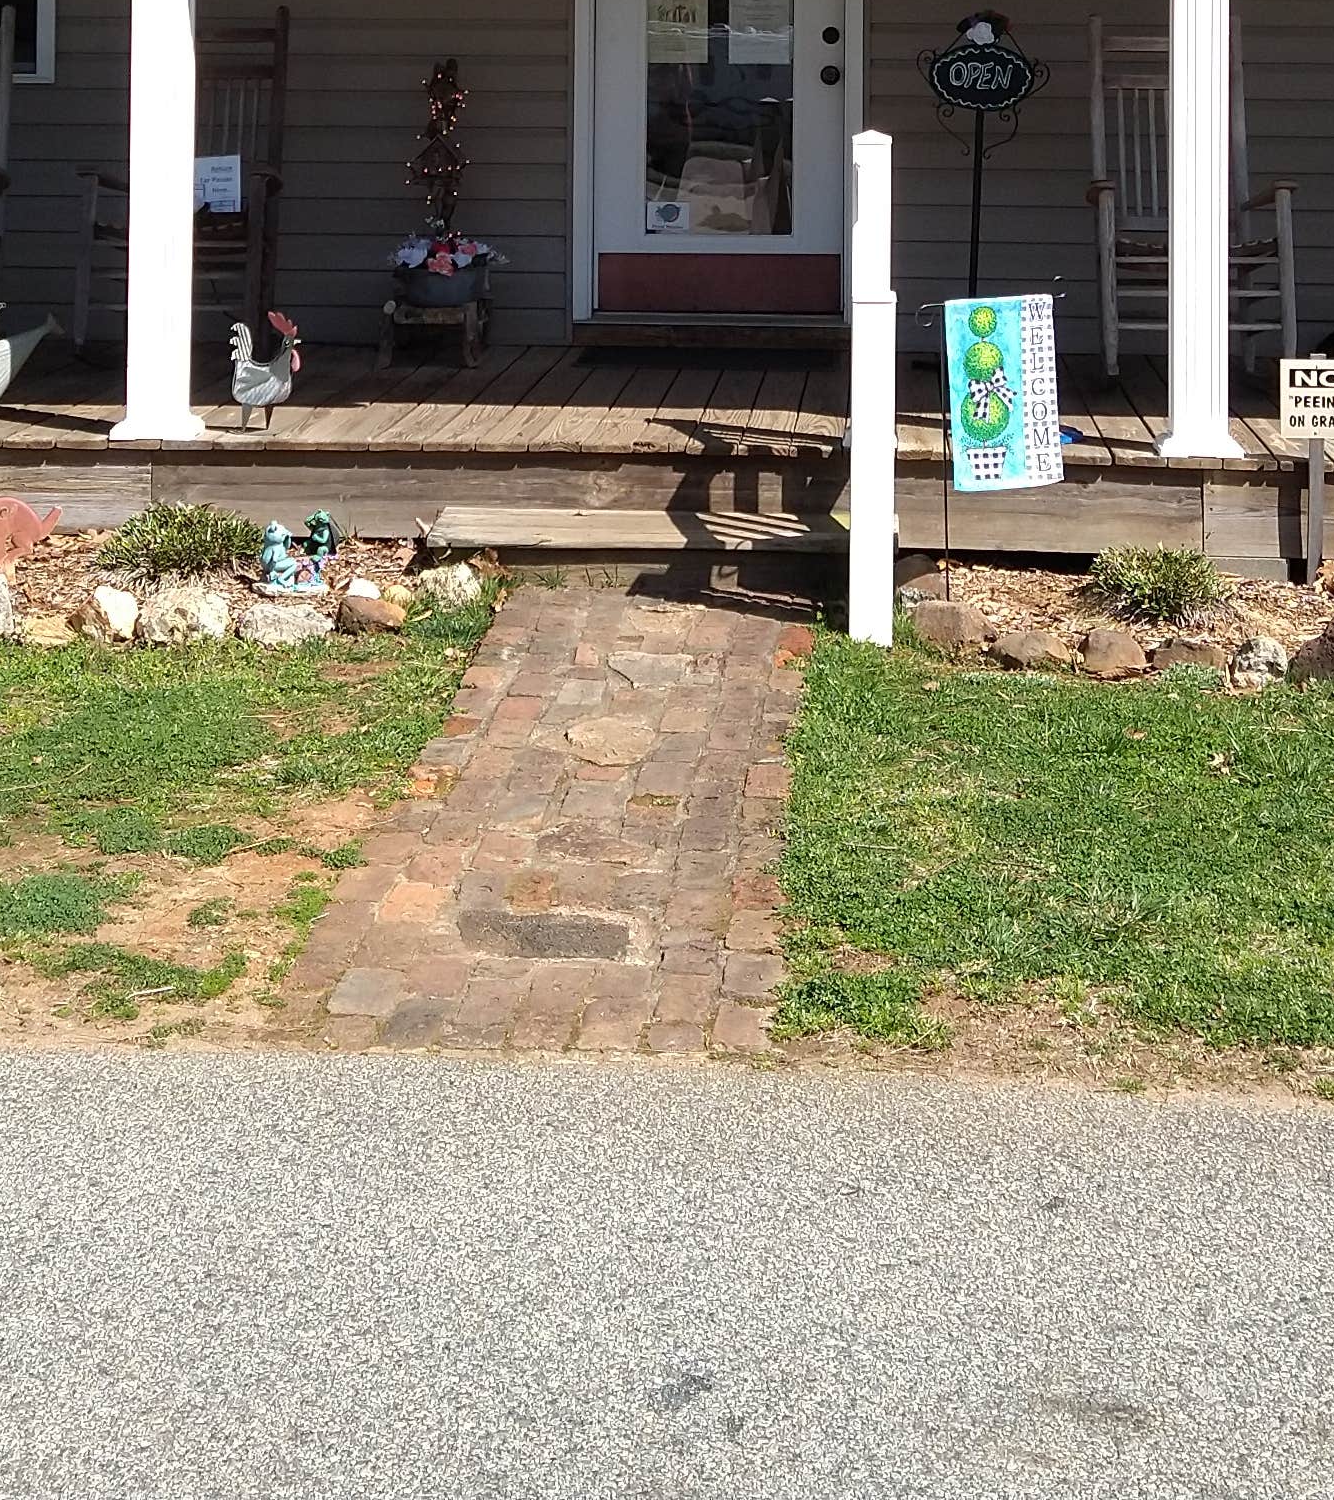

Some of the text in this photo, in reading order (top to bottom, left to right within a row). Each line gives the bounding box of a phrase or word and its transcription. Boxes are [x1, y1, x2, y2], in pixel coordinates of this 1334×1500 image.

[949, 61, 1014, 90] OPEN
[1028, 301, 1053, 472] WELCOME
[1289, 415, 1306, 428] ON
